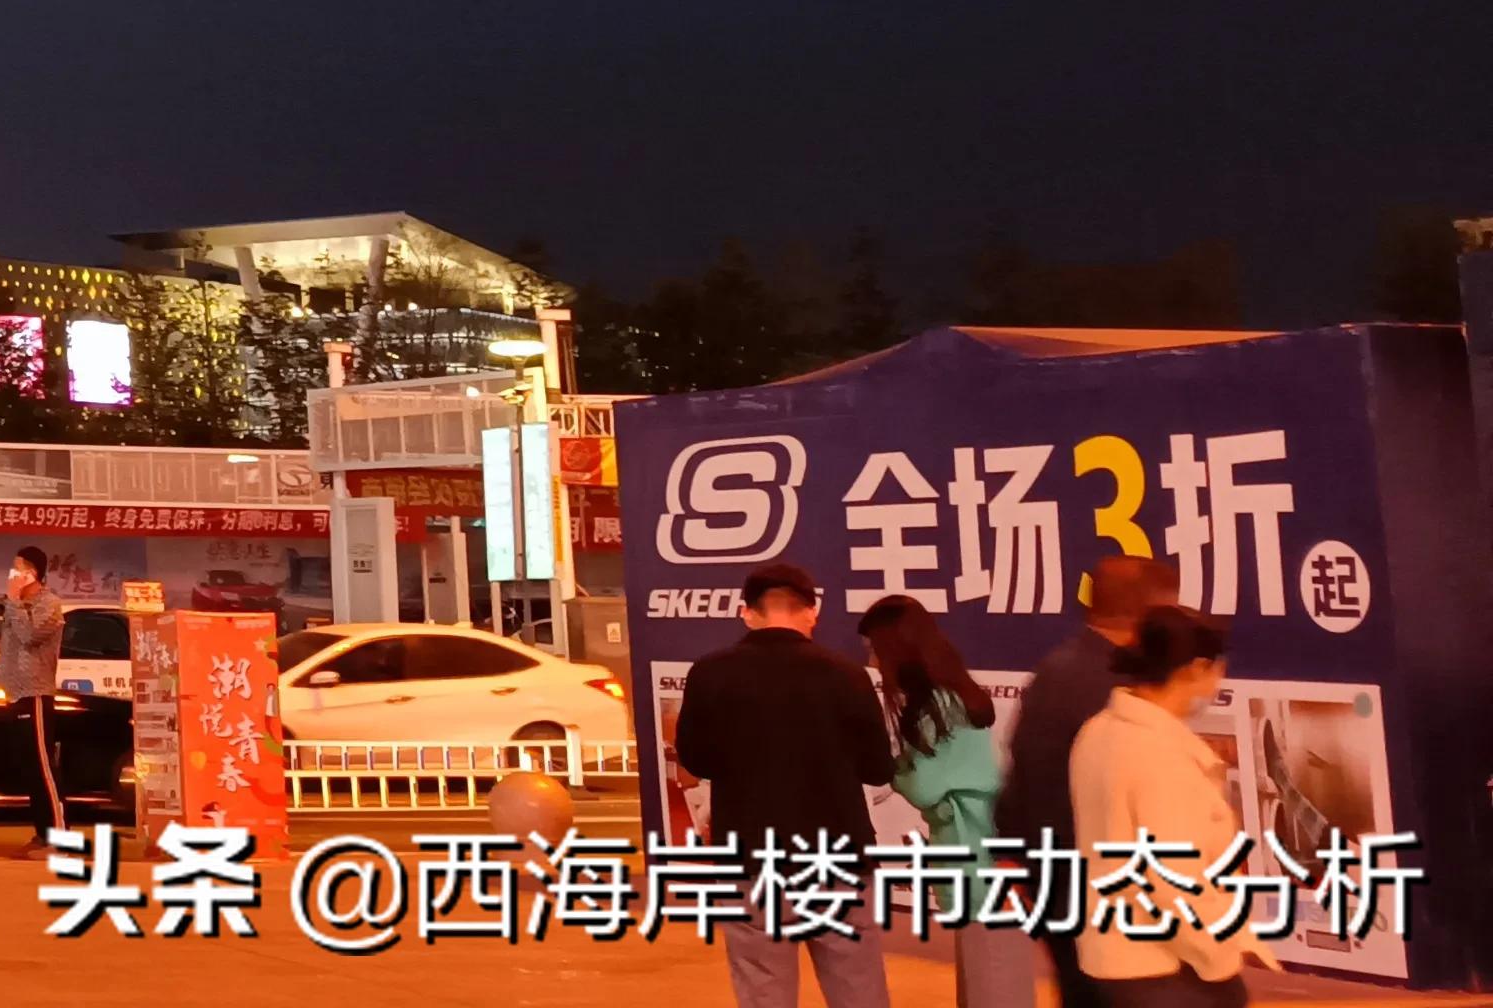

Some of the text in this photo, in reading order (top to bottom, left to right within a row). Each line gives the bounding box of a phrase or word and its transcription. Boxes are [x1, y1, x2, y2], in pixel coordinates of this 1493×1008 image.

[841, 429, 1295, 616] 全场3折
[646, 588, 825, 619] SKECH
